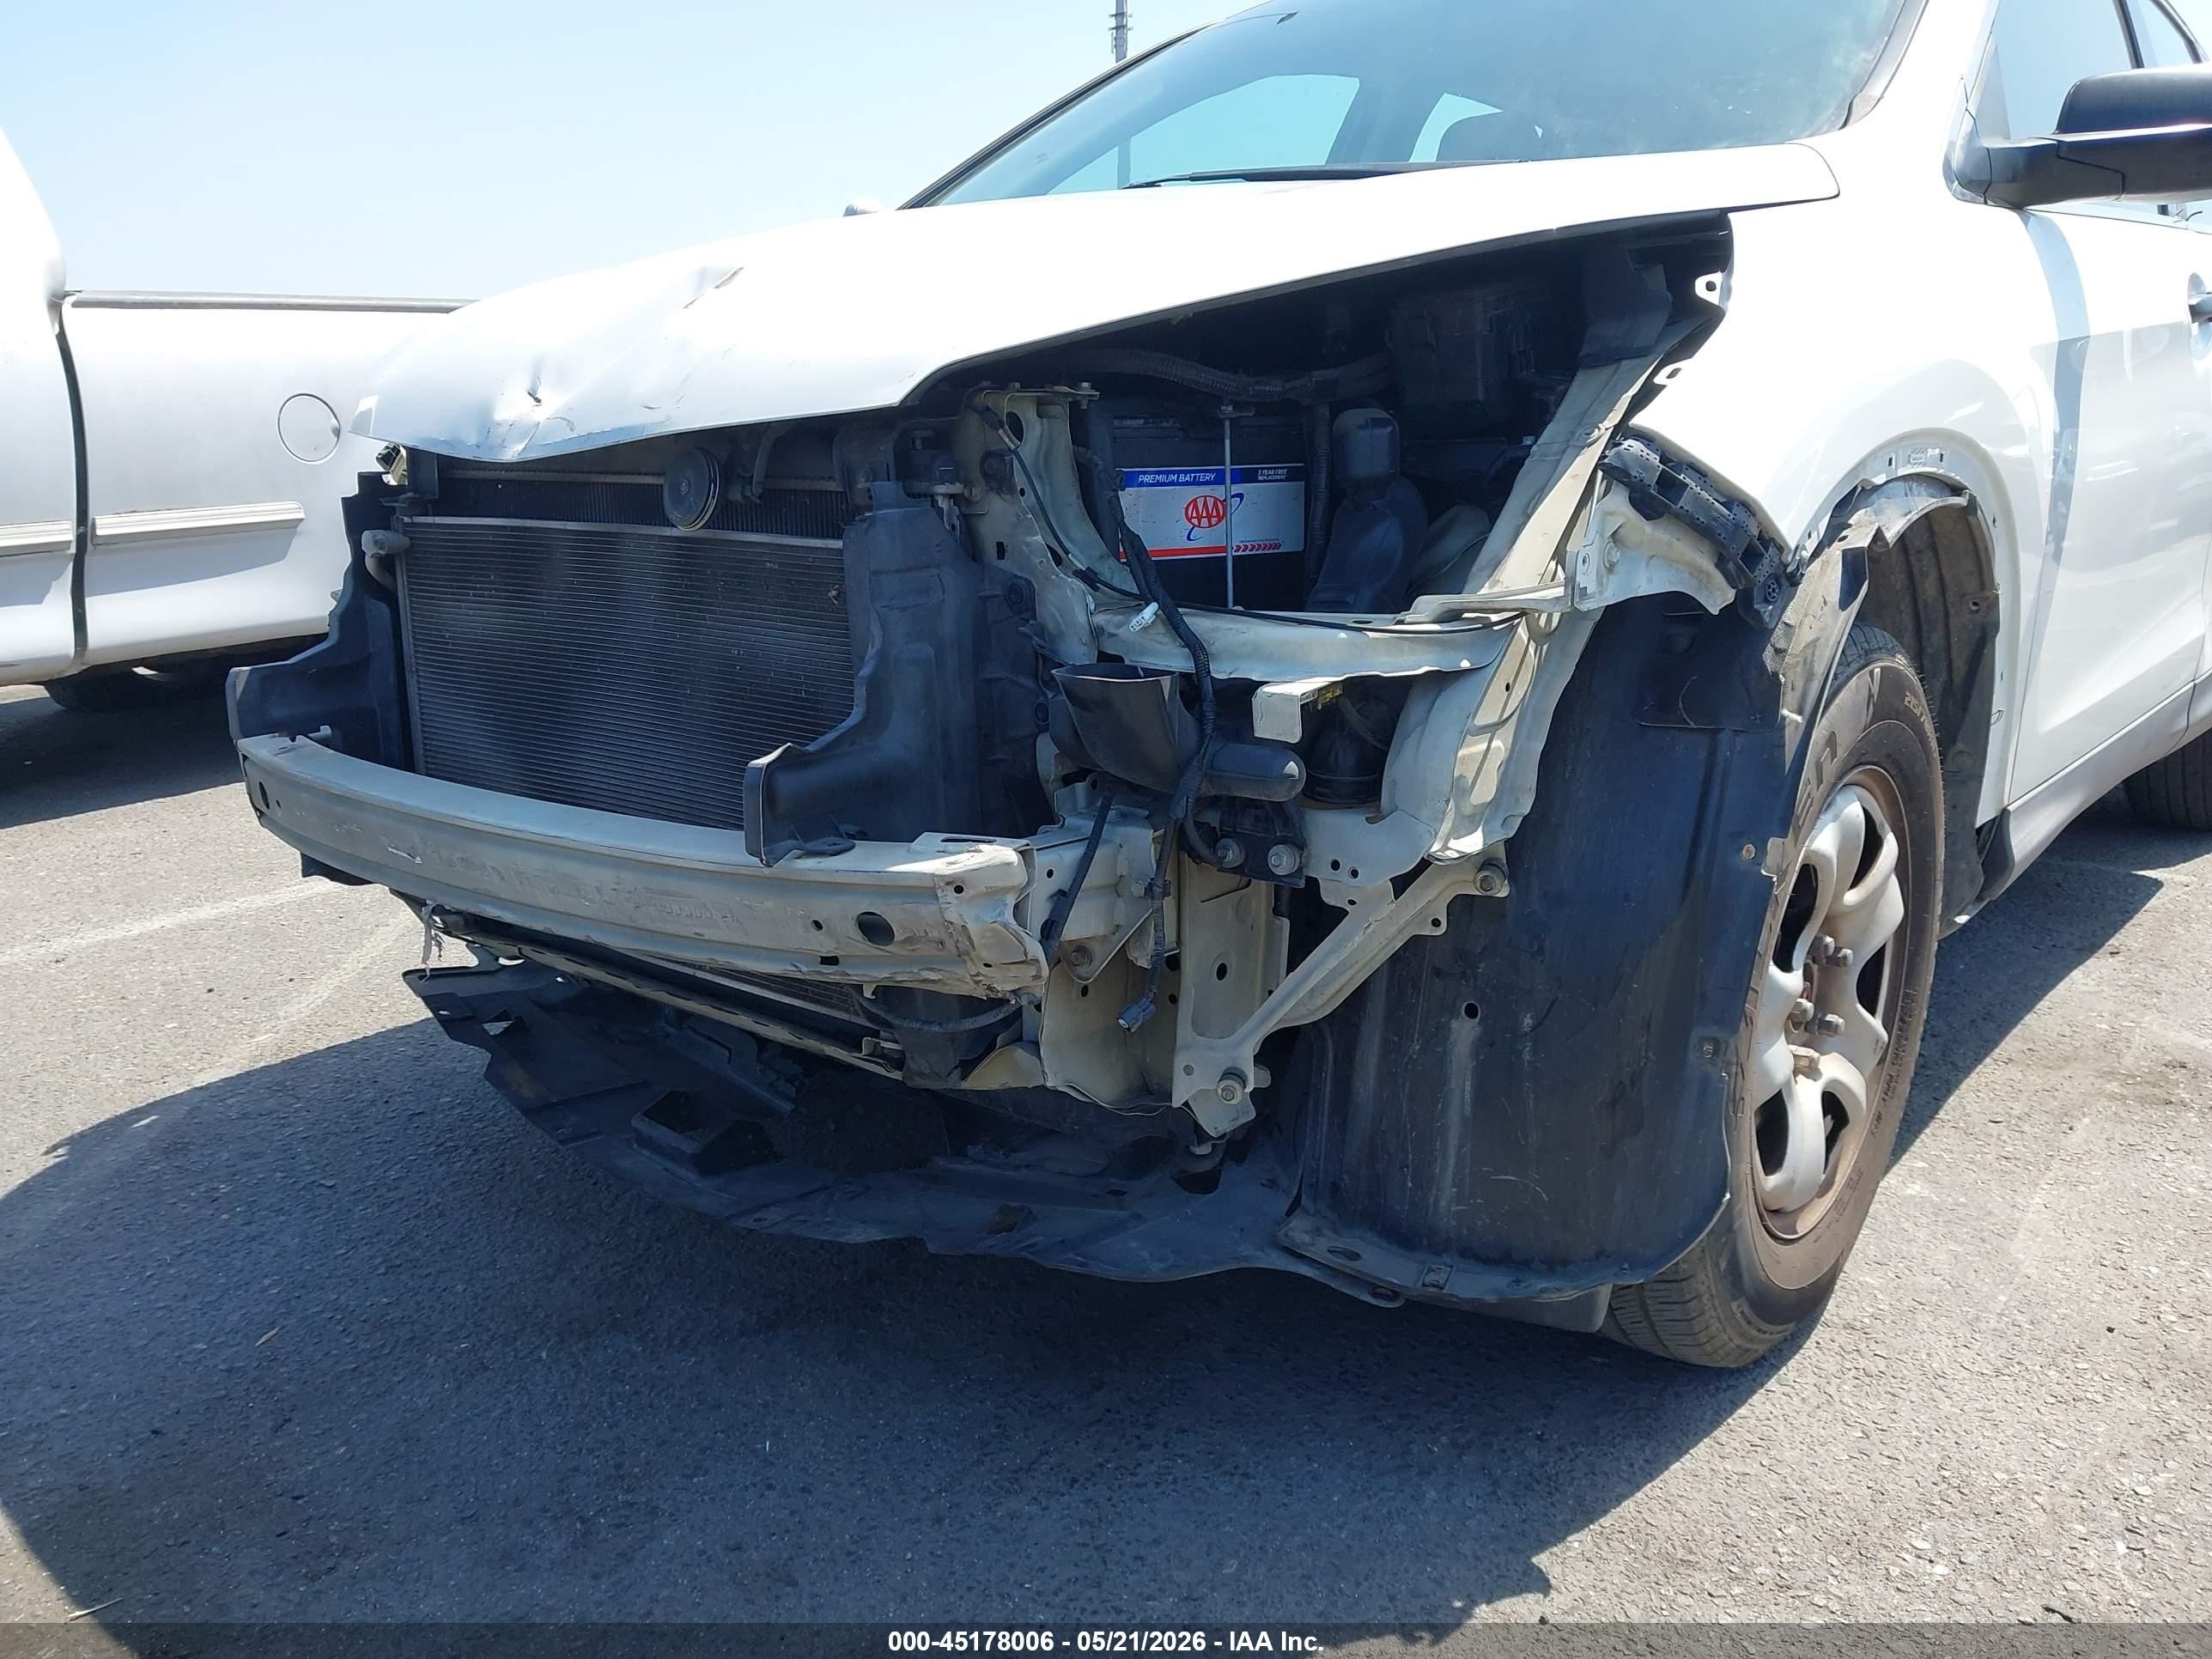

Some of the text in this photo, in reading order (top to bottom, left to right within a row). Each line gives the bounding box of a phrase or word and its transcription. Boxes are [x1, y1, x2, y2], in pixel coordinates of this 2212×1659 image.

[1138, 472, 1217, 483] PREMIUM BATTERY
[1186, 495, 1225, 527] AAA
